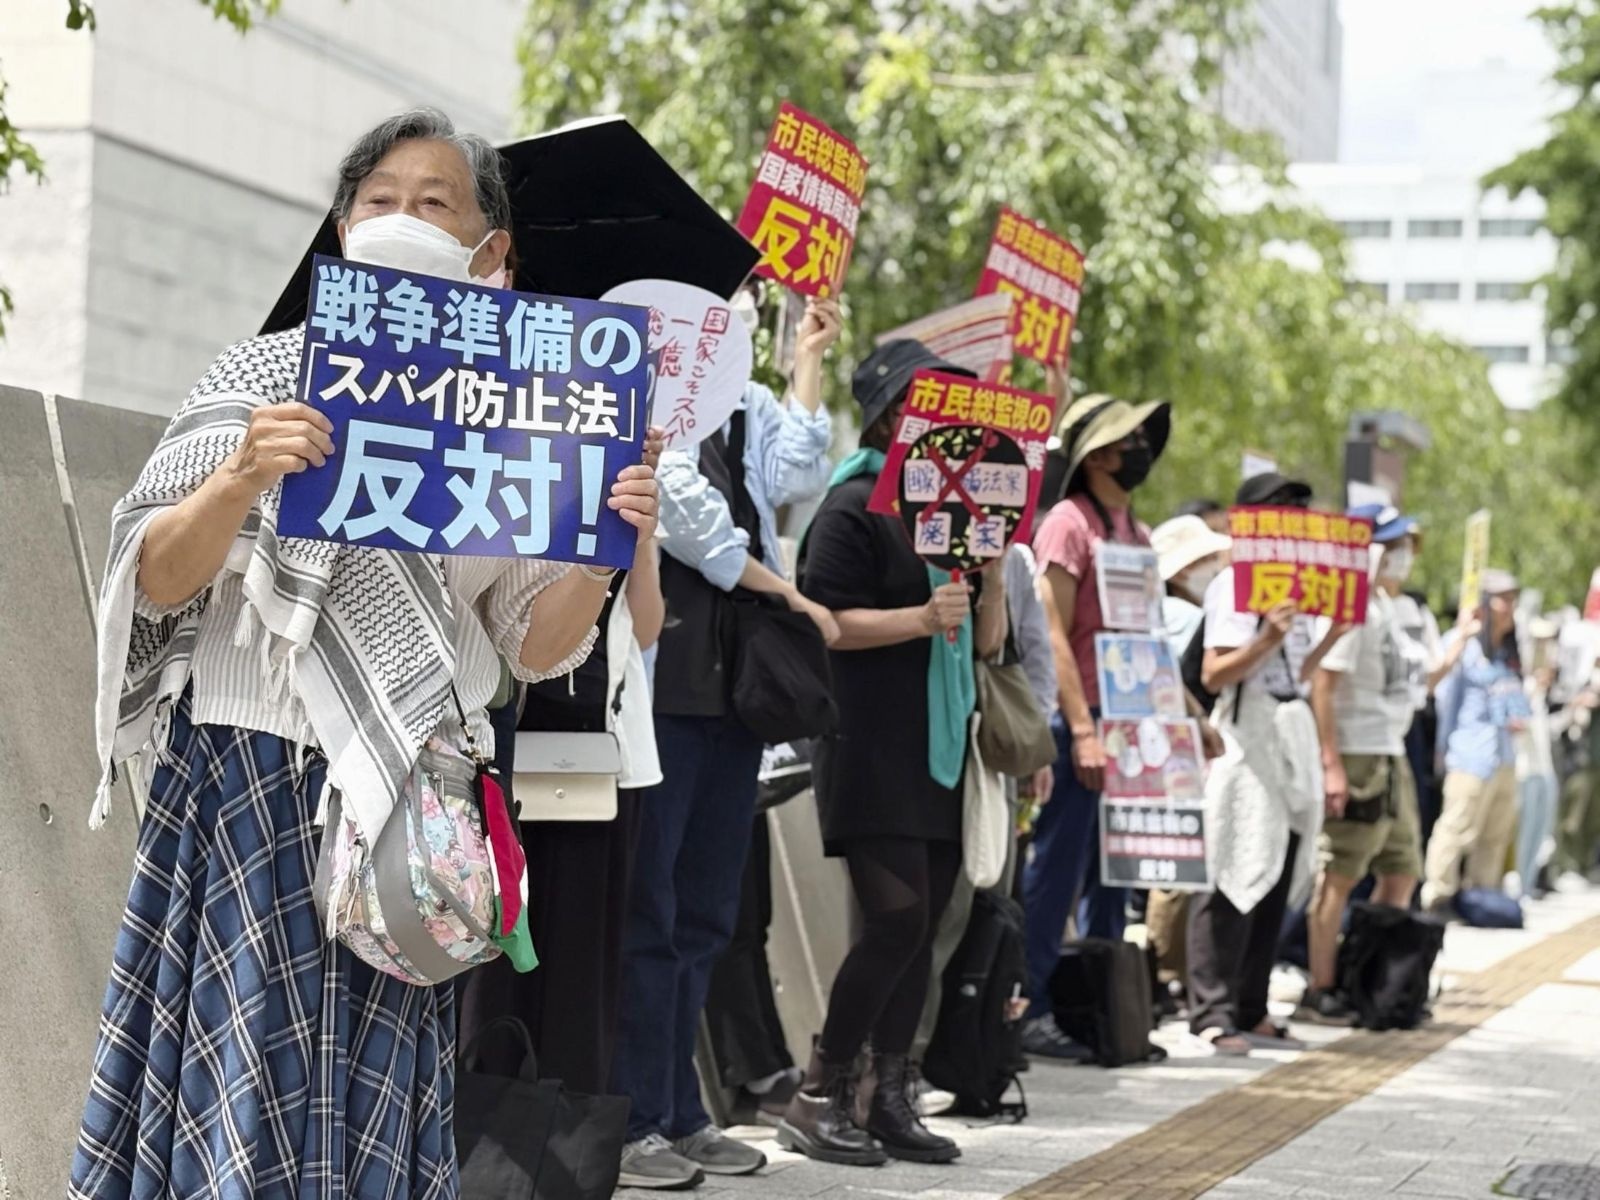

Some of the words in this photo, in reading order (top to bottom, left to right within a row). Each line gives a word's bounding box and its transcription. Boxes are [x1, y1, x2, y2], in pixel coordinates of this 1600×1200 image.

[311, 265, 641, 376] 戦争準備の
[303, 342, 636, 442] 「スパイ防止法」
[911, 377, 1051, 434] 市民総監視の
[317, 419, 606, 557] 反対!
